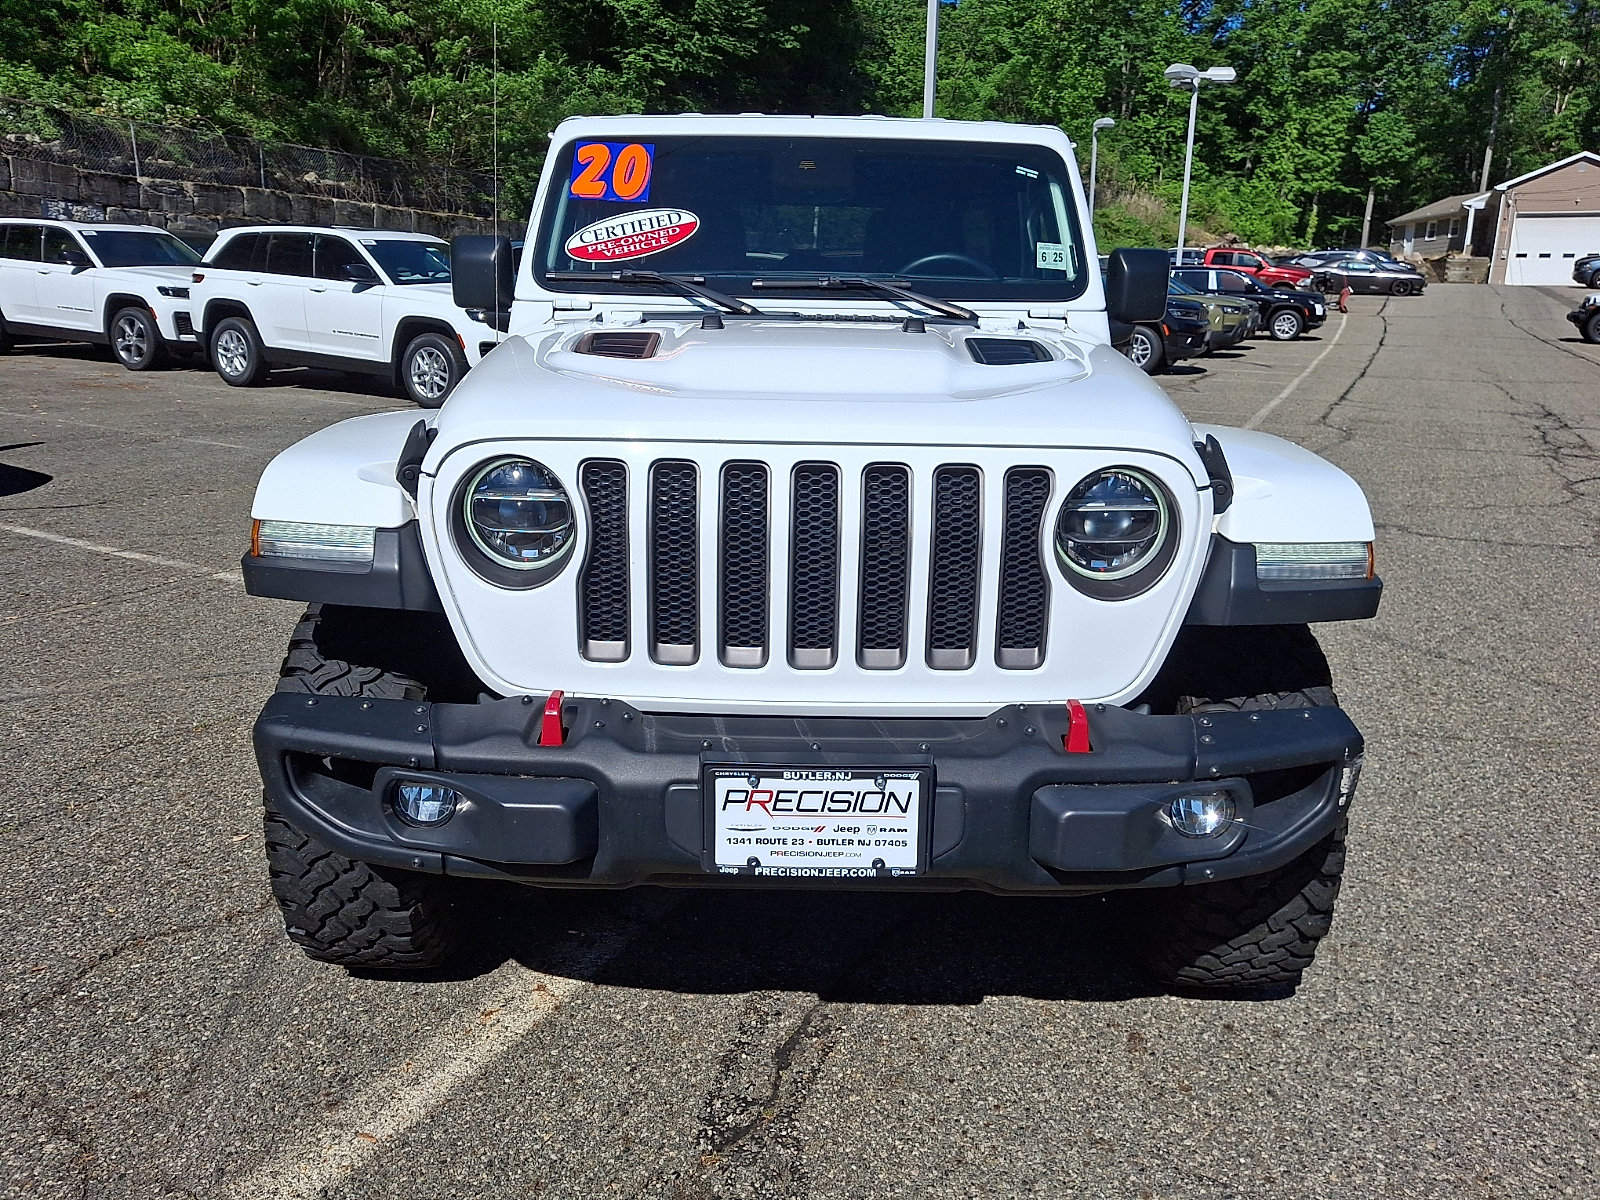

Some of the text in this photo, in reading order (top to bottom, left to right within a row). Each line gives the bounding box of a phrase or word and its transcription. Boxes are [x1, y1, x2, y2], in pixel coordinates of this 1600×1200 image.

[571, 143, 651, 200] 20
[579, 212, 682, 244] CERTIFIED
[586, 226, 681, 254] PRE-OWNED
[601, 236, 670, 257] VEHICLE
[1041, 252, 1063, 262] 6 25
[722, 789, 912, 816] PRECISION
[833, 824, 861, 834] Jeep
[755, 838, 788, 846] ROUTE
[791, 838, 805, 846] 23
[816, 838, 855, 847] BUTLER
[857, 839, 871, 847] NJ
[874, 839, 908, 848] 07405
[719, 866, 739, 875] Jeep
[755, 867, 877, 878] PRECISIONJEEP.COM
